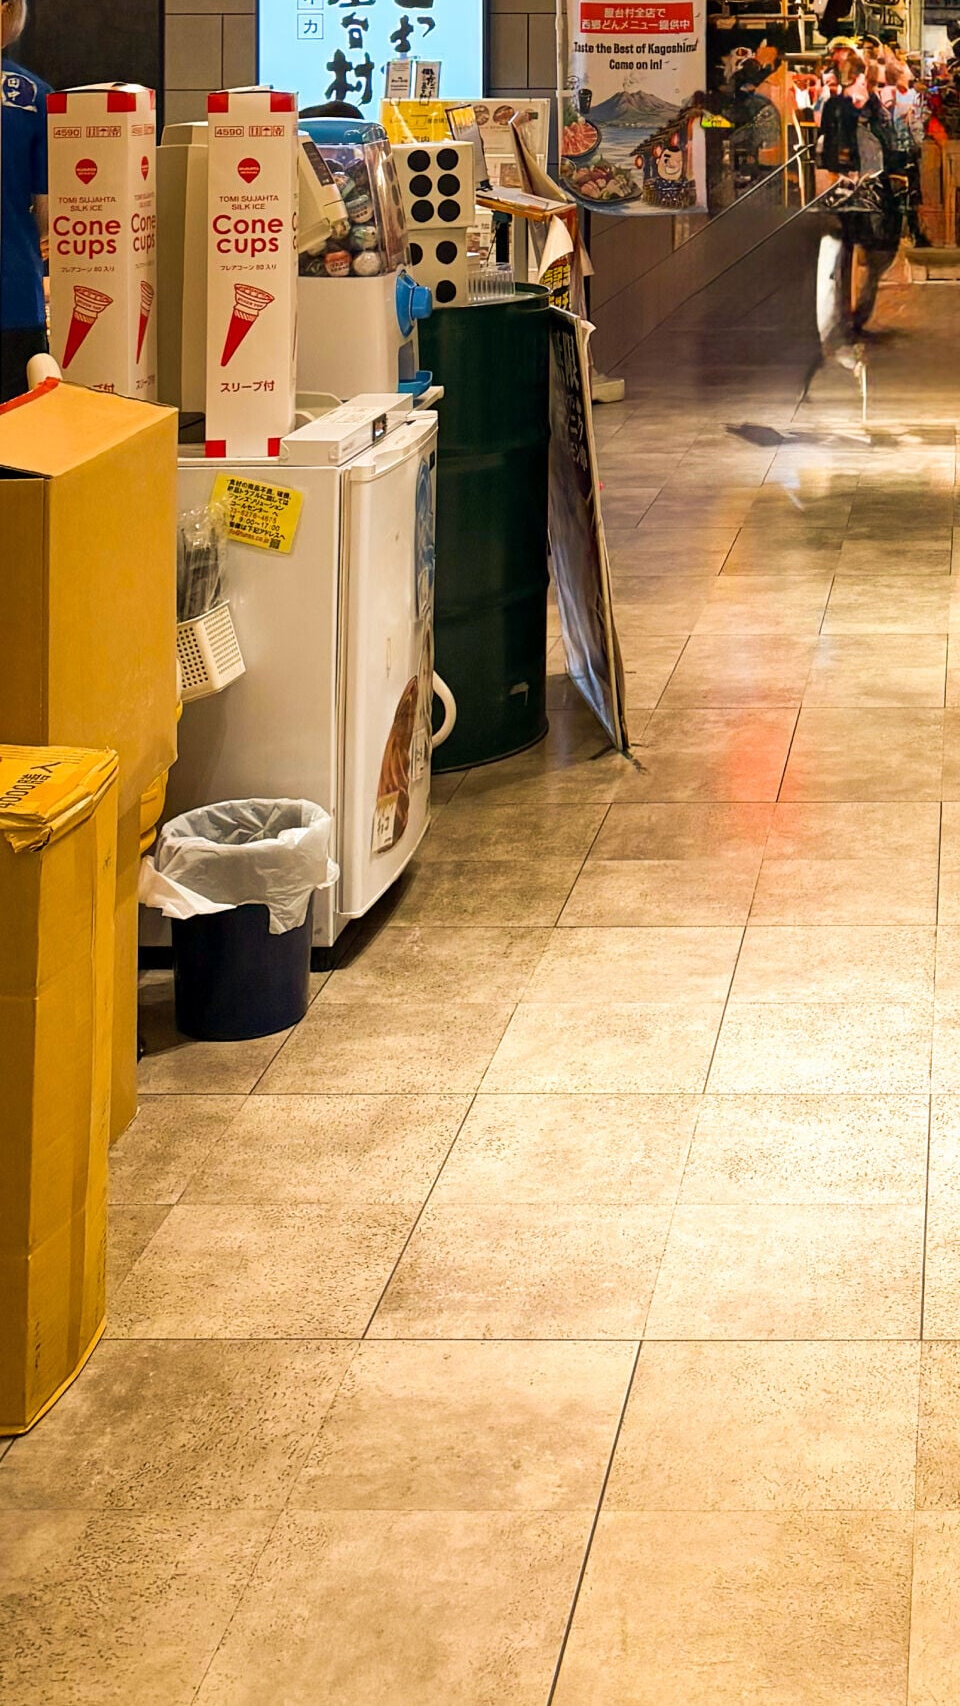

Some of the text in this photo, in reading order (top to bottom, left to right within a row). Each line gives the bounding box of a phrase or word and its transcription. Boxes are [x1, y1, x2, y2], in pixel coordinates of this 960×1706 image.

[597, 43, 612, 54] the
[614, 43, 634, 54] Best
[636, 43, 647, 54] of
[609, 59, 634, 70] Come
[636, 61, 648, 70] on
[55, 128, 80, 137] 4590
[216, 128, 243, 136] 4590
[53, 215, 121, 236] Cone
[212, 214, 283, 235] Cone
[57, 238, 117, 260] cups
[216, 237, 279, 258] cups
[220, 380, 275, 393] スリーブ付
